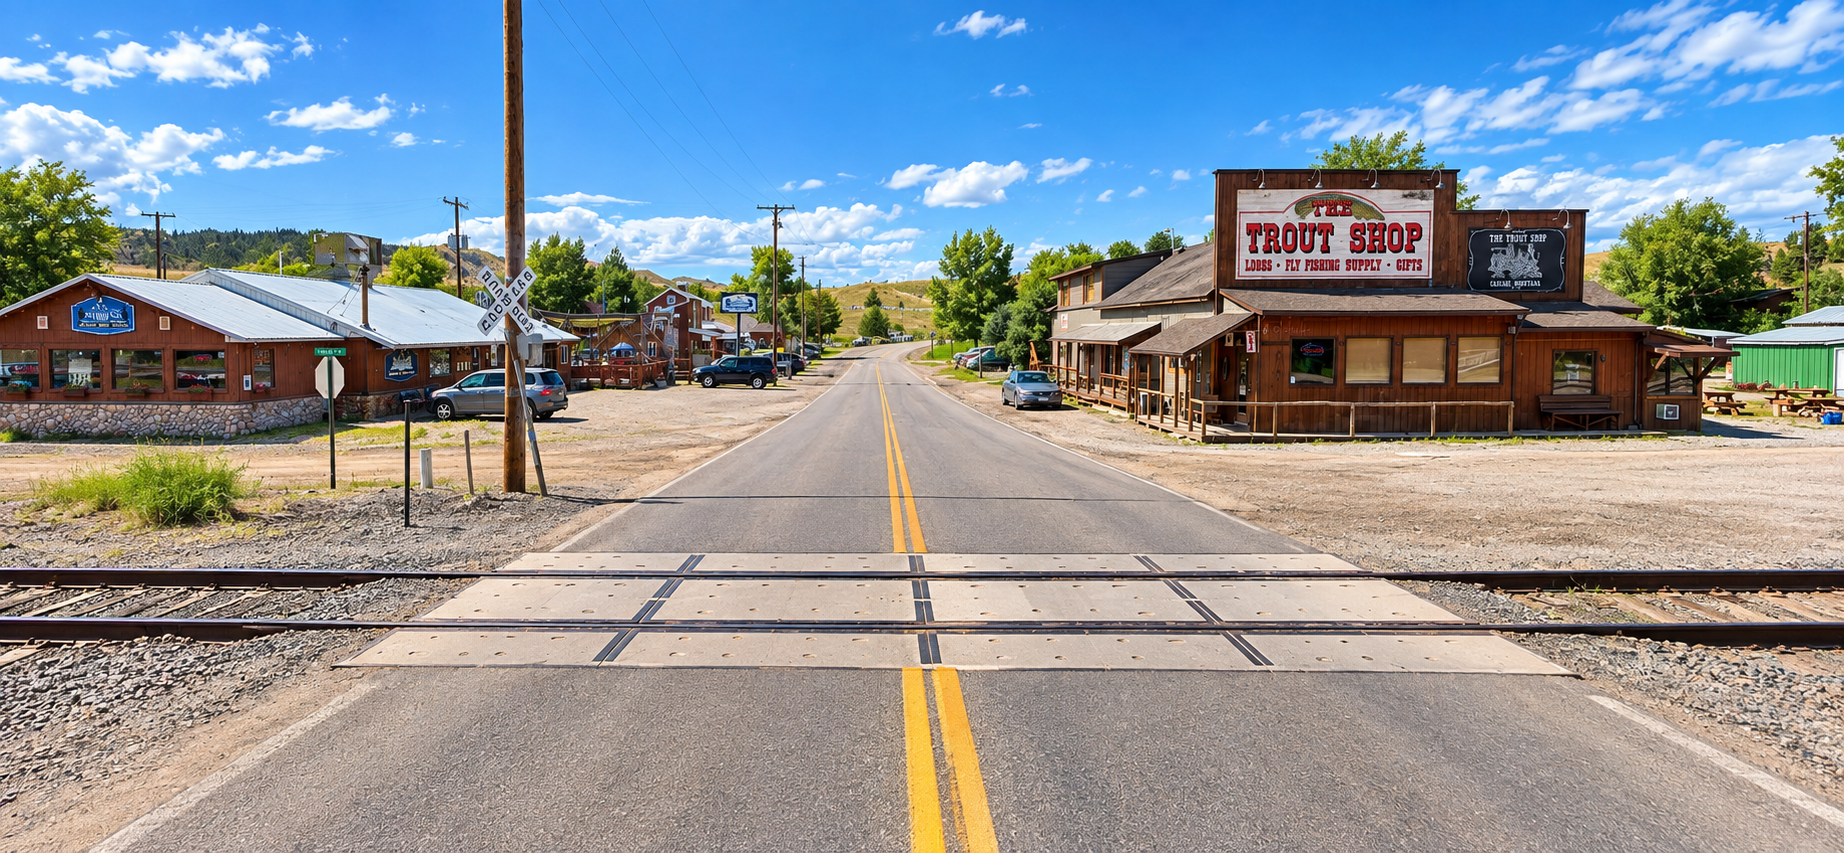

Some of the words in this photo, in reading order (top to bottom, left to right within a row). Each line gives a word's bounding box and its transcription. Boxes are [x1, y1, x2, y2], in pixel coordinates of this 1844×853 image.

[1246, 222, 1335, 254] TROUT
[1350, 222, 1423, 254] SHOP
[1285, 258, 1302, 272] FLY
[1304, 258, 1340, 272] FISHING
[1345, 258, 1382, 272] SUPPLY
[1396, 258, 1423, 272] GIFTS
